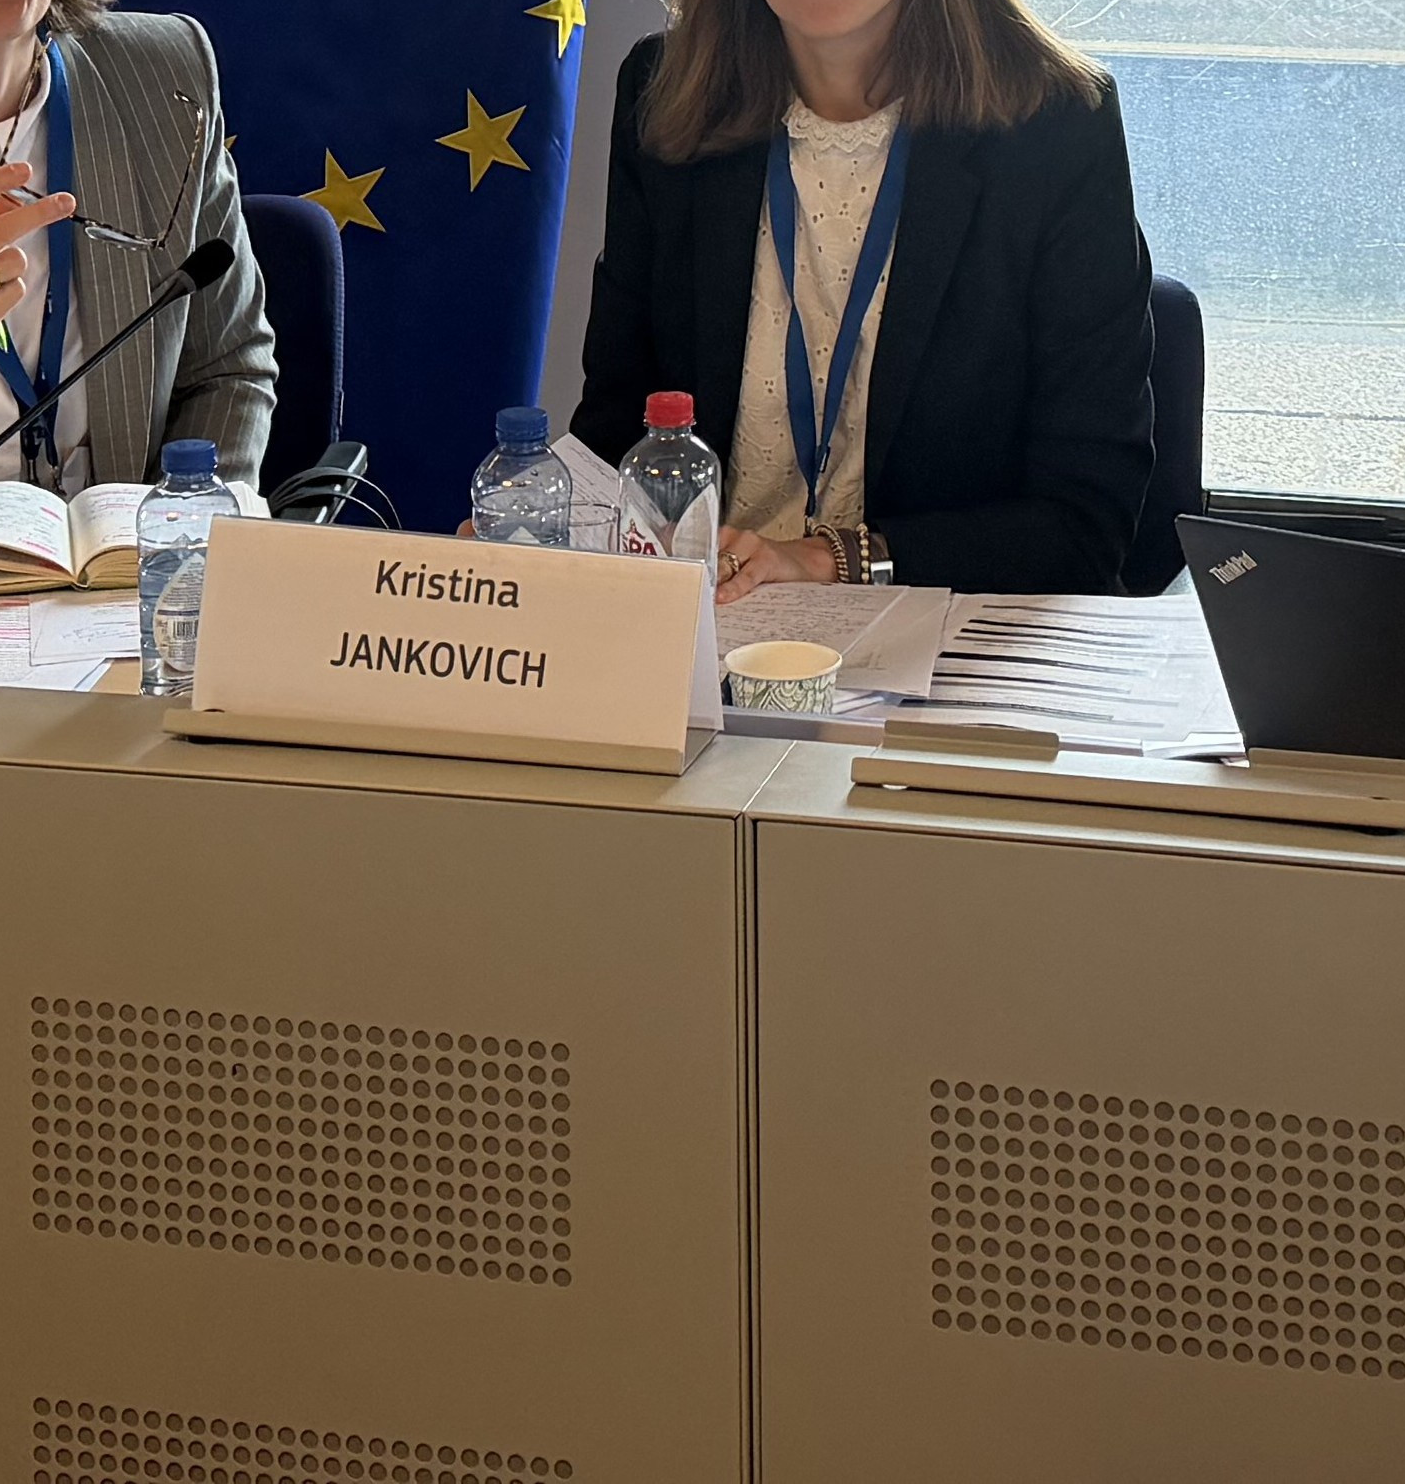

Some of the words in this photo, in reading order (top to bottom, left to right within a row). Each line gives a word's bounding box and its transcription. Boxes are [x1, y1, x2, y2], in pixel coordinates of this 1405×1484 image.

[375, 559, 520, 609] Kristina
[1208, 549, 1258, 585] ThinkPad
[329, 631, 547, 688] JANKOVICH
